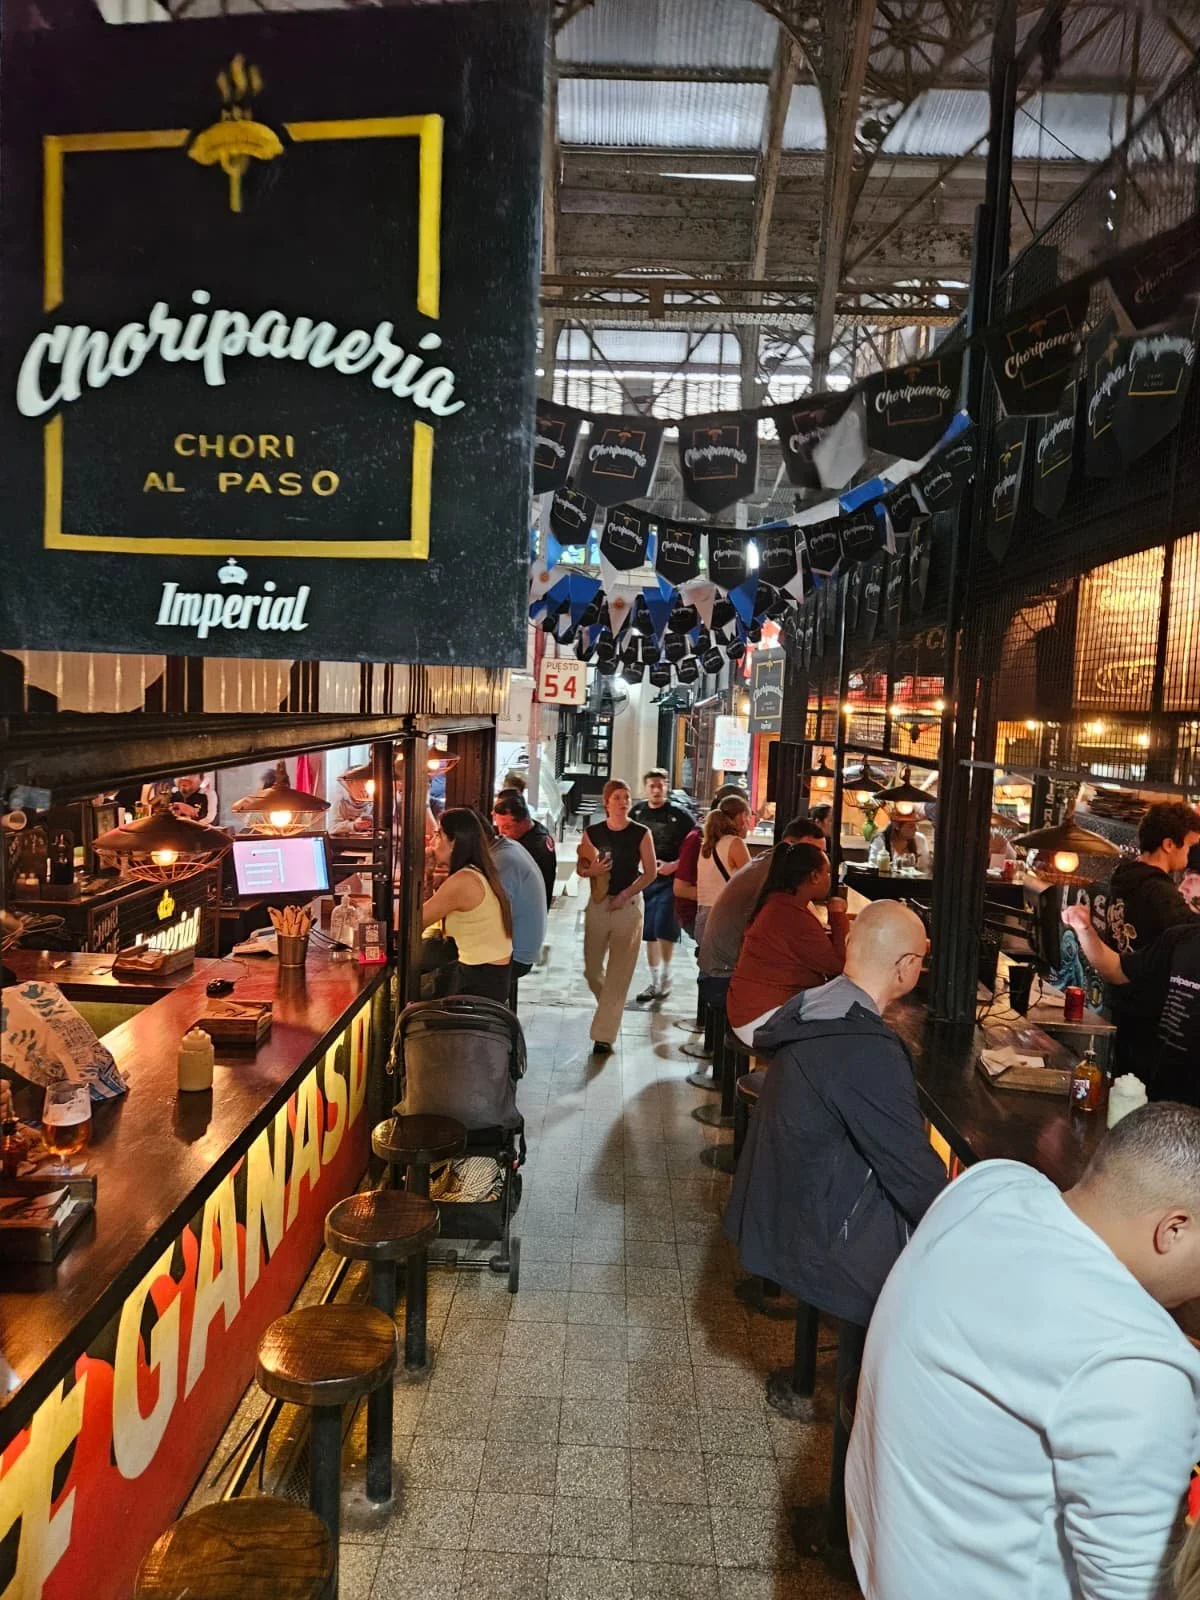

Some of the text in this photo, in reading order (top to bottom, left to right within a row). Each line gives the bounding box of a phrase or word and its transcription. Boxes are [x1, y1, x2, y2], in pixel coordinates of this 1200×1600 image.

[174, 433, 295, 458] CHORI
[143, 470, 341, 497] AL PASO
[155, 580, 311, 639] Imperial
[546, 661, 580, 673] PUESTO
[544, 674, 577, 699] 54
